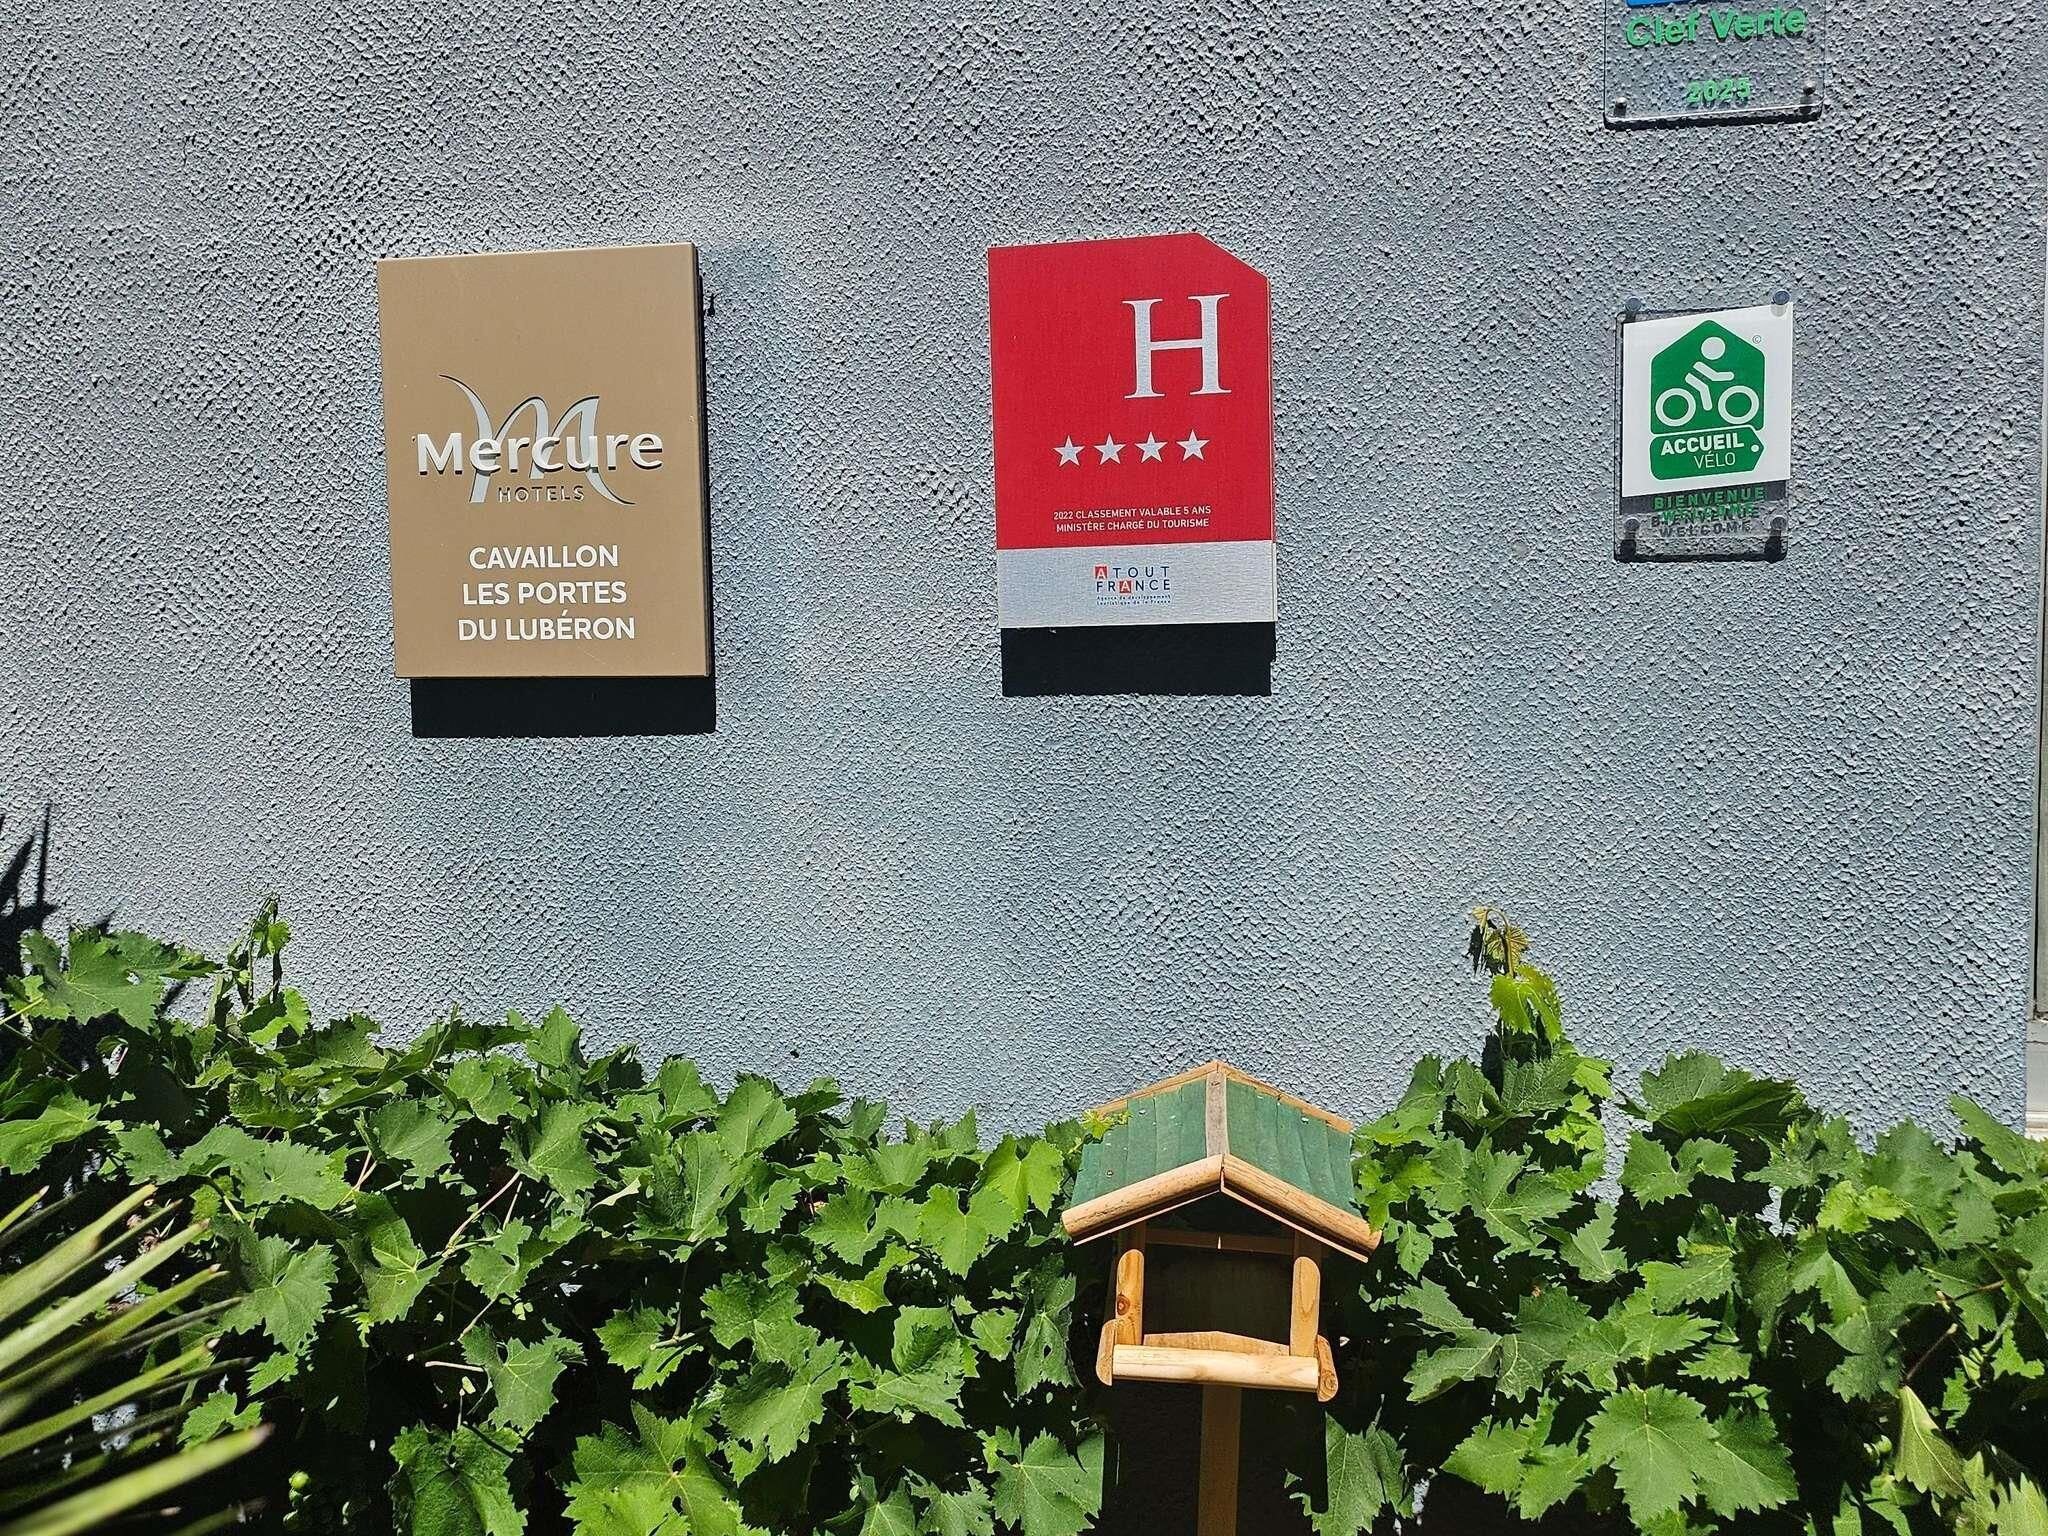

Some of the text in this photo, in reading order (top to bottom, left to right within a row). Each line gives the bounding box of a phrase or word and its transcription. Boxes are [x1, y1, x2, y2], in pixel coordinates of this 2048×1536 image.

[1626, 7, 1807, 46] Clef Verte
[1687, 78, 1750, 103] 2025
[1122, 293, 1232, 399] H
[416, 432, 663, 474] Mercure
[1661, 432, 1745, 456] ACCUEIL
[1694, 451, 1736, 469] VÉLO
[498, 485, 585, 503] HOTELS
[1653, 487, 1765, 510] BIENVENUE
[1053, 505, 1211, 520] 2022 CLASSEMENT VALABLE 5 ANS
[1056, 518, 1209, 532] MINISTÈRE CHARGÉ DU TOURISME
[469, 545, 619, 569] CAVAILLON
[463, 581, 627, 605] LES PORTES
[1096, 579, 1170, 593] FRANCE
[458, 609, 635, 640] DU LUBÉRON
